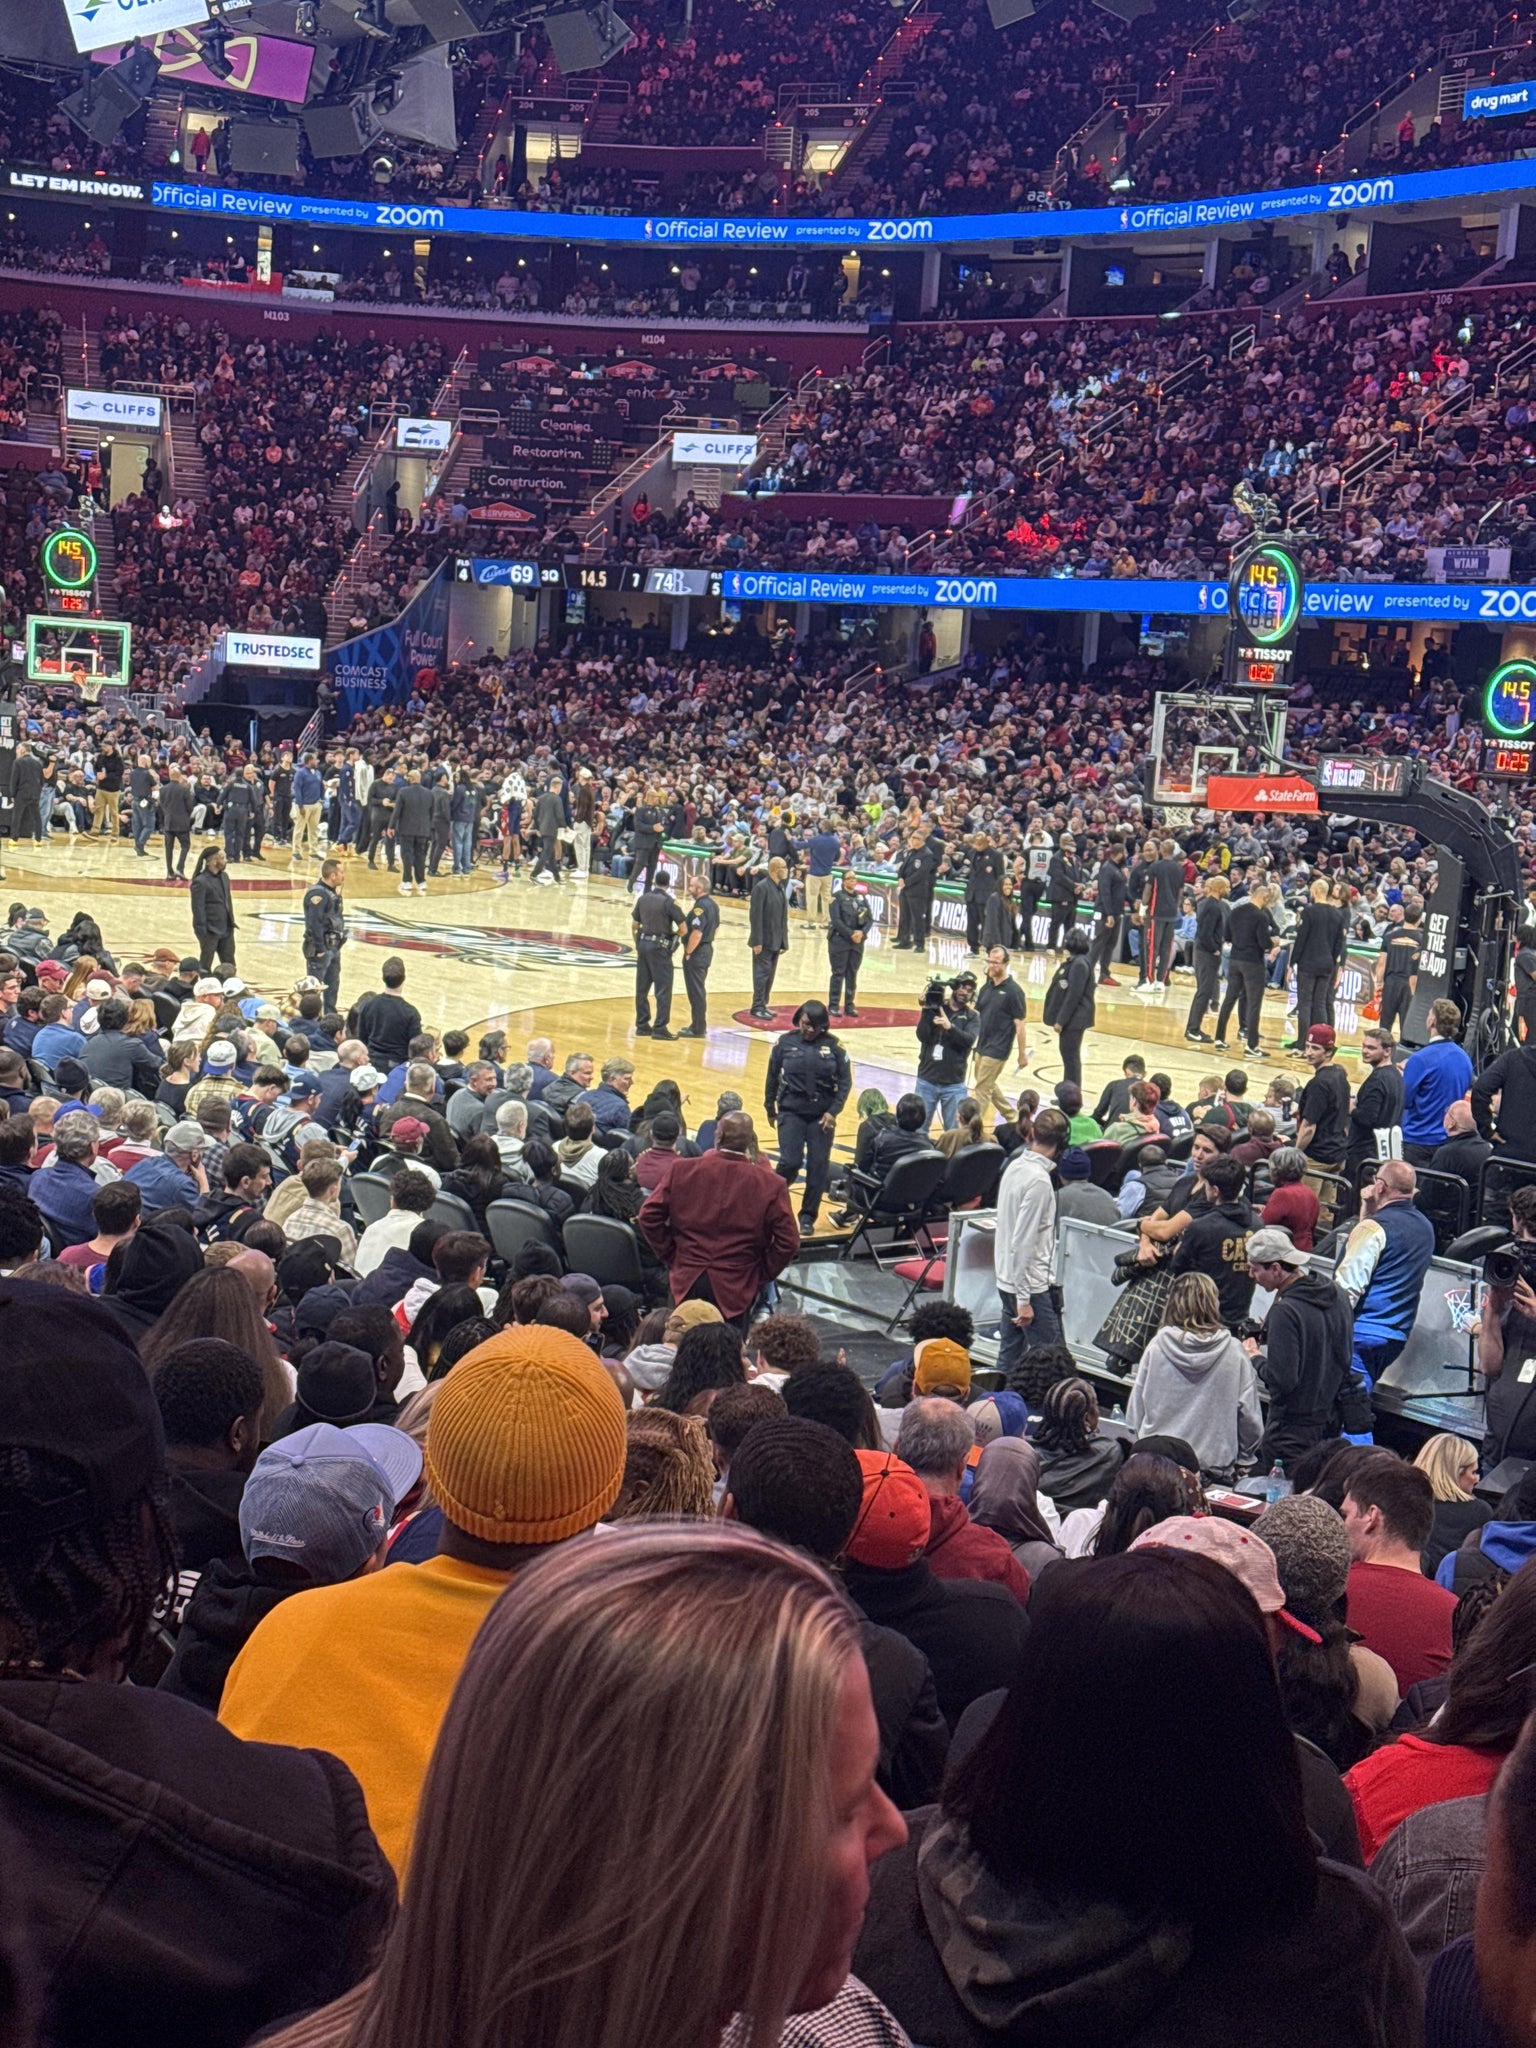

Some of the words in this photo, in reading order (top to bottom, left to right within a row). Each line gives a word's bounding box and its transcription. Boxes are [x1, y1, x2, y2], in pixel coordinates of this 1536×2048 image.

[1471, 96, 1499, 110] drug
[1500, 89, 1529, 104] mart
[10, 172, 47, 189] LET
[49, 176, 78, 192] EM
[80, 180, 144, 199] KNOW.
[222, 194, 292, 215] Review
[301, 205, 353, 217] presented
[356, 207, 369, 219] by
[1131, 205, 1192, 228] Official
[1196, 200, 1254, 222] Review
[1261, 194, 1308, 211] presented
[1309, 193, 1322, 205] by
[655, 221, 718, 238] Official
[723, 221, 788, 239] Review
[796, 226, 846, 236] presented
[848, 225, 861, 237] by
[264, 310, 290, 322] M103
[641, 334, 665, 345] M104
[102, 402, 156, 417] CLIFFS
[512, 444, 584, 460] Restoration.
[704, 443, 753, 455] CLIFFS
[487, 474, 566, 490] Construction.
[480, 508, 522, 519] SERVPRO
[58, 540, 82, 556] 14.5
[72, 556, 86, 581] 7
[1454, 558, 1479, 569] WTAM
[458, 568, 469, 581] 4
[510, 564, 533, 584] 69
[541, 569, 559, 582] 3Q
[580, 569, 607, 588] 14.5
[632, 573, 640, 588] 7
[654, 572, 674, 591] 74
[711, 582, 720, 596] 5
[1250, 565, 1278, 587] 14.5
[61, 589, 92, 598] TISSOT
[743, 575, 807, 597] Official
[810, 578, 866, 598] Review
[872, 584, 916, 595] presented
[917, 584, 929, 597] by
[1384, 596, 1450, 609] presented
[1453, 595, 1470, 611] by
[405, 629, 420, 647] Full
[421, 631, 444, 650] Court
[233, 642, 314, 659] TRUSTEDSEC
[410, 649, 437, 667] Power
[1253, 649, 1292, 661] TISSOT
[335, 664, 388, 678] COMCAST
[335, 676, 387, 690] BUSINESS
[1502, 681, 1530, 700] 14.5
[1518, 701, 1530, 725] 7
[1497, 739, 1535, 750] TISSOT
[1332, 770, 1349, 786] NBA
[1349, 769, 1365, 787] CUP
[939, 901, 969, 932] NIGH
[1428, 913, 1449, 934] GET
[1427, 933, 1446, 953] THE
[1428, 954, 1447, 978] App
